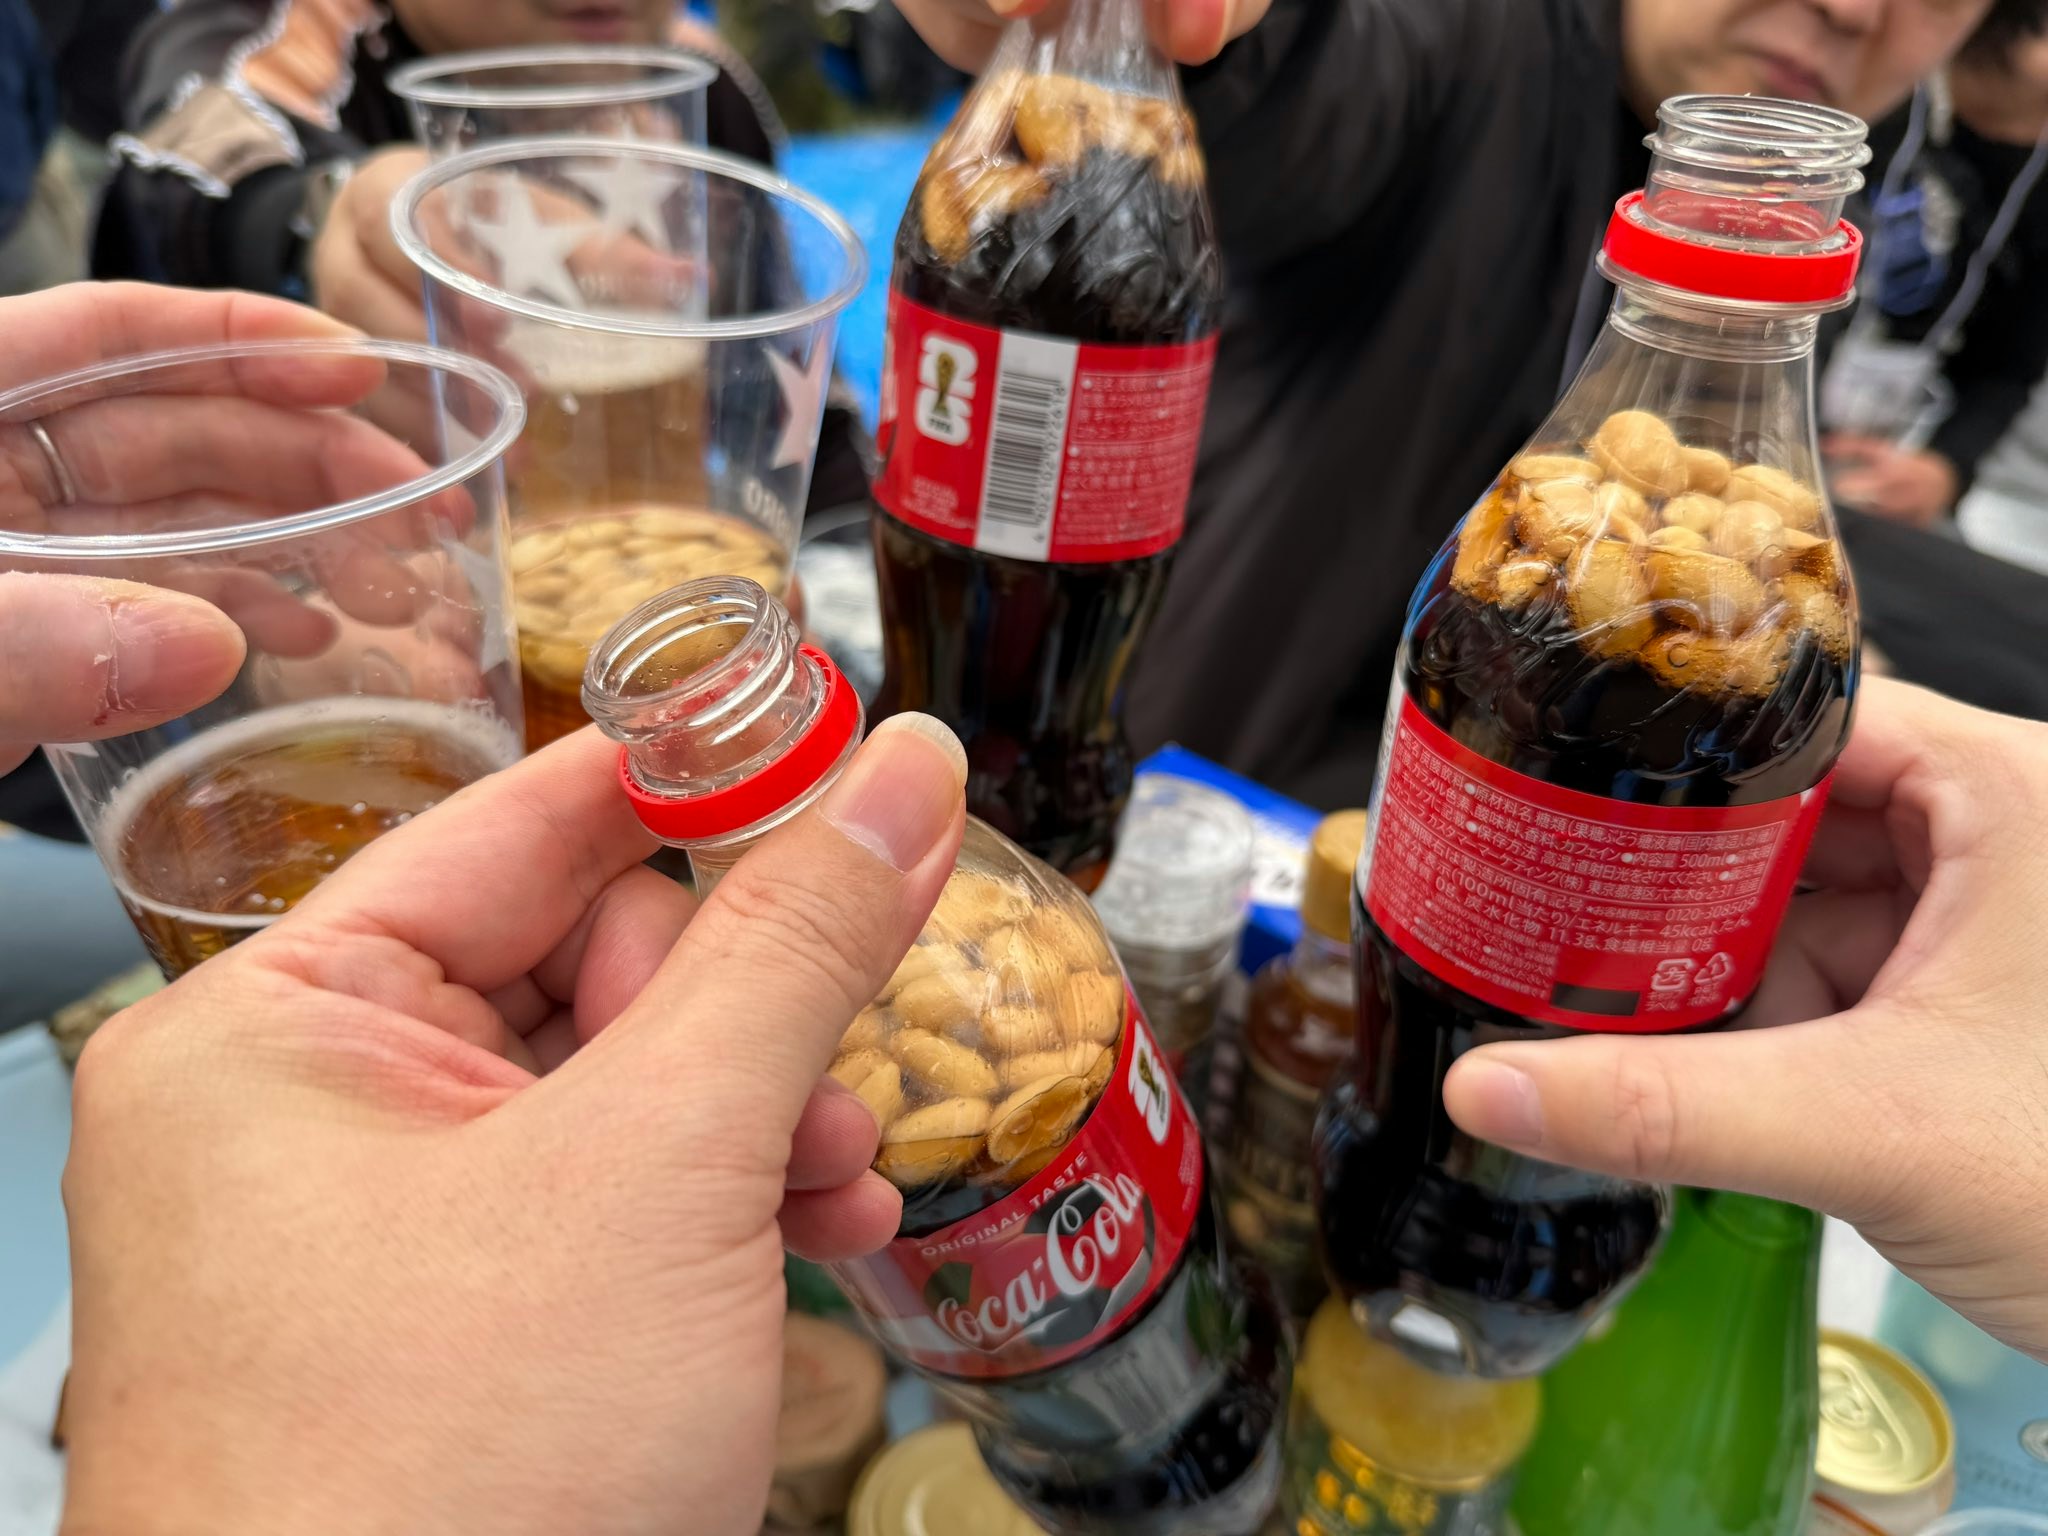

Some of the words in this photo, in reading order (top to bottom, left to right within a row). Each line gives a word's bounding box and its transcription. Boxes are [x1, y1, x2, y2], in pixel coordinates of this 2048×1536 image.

[1419, 748, 1466, 788] 炭酸飲料
[1475, 786, 1532, 824] 原材料名
[1477, 823, 1538, 861] 保存方法
[1680, 850, 1727, 868] 500ml
[921, 1209, 1026, 1258] ORIGINAL
[1029, 1151, 1090, 1212] TASTE
[937, 1171, 1144, 1353] Coca-Cola
